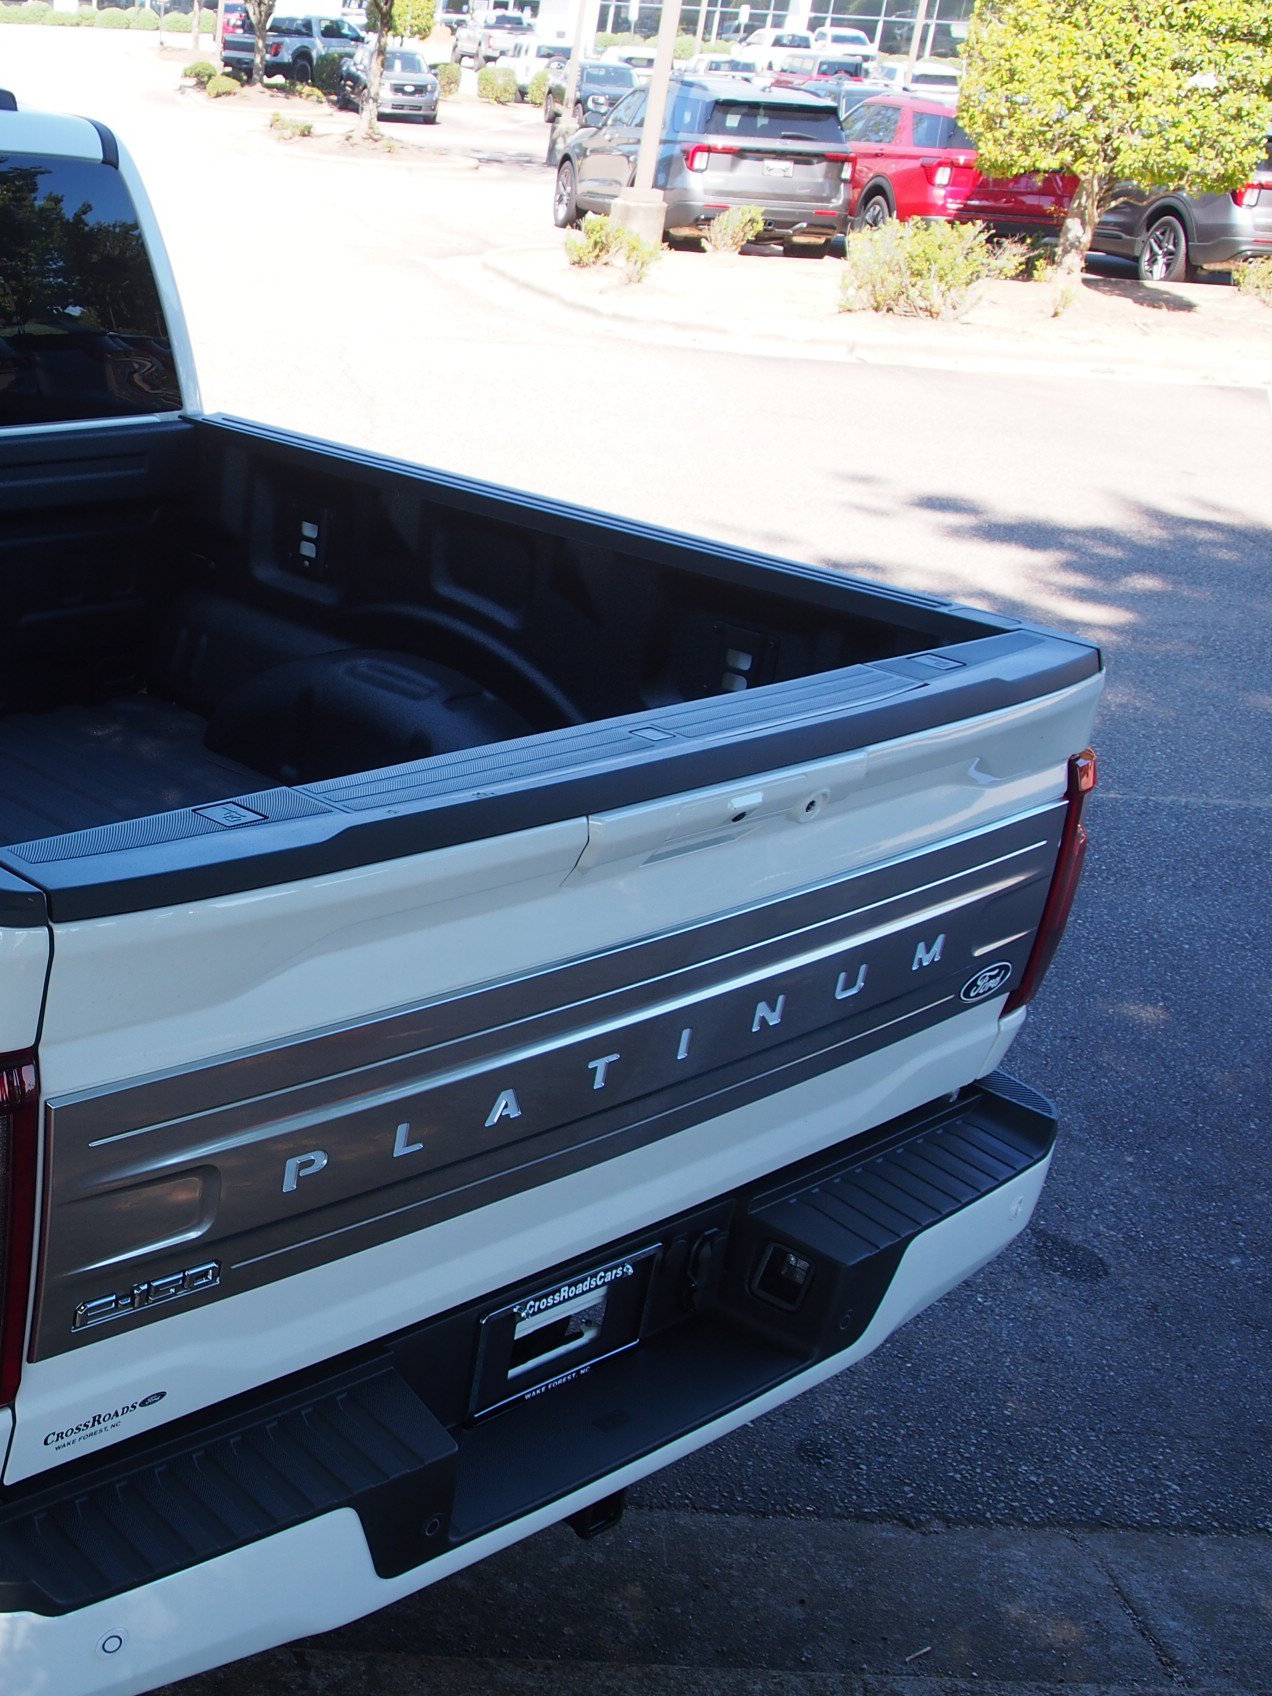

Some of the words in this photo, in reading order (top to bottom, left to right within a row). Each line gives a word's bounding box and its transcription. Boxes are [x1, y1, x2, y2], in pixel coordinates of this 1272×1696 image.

[967, 967, 1007, 998] Ford
[281, 932, 947, 1193] PLATINUM
[71, 1259, 221, 1333] F-150
[525, 1265, 624, 1315] CrossRoadsCars
[524, 1386, 546, 1400] WAKE
[580, 1365, 591, 1375] NC
[54, 1438, 77, 1452] WAKE
[110, 1420, 122, 1430] NC
